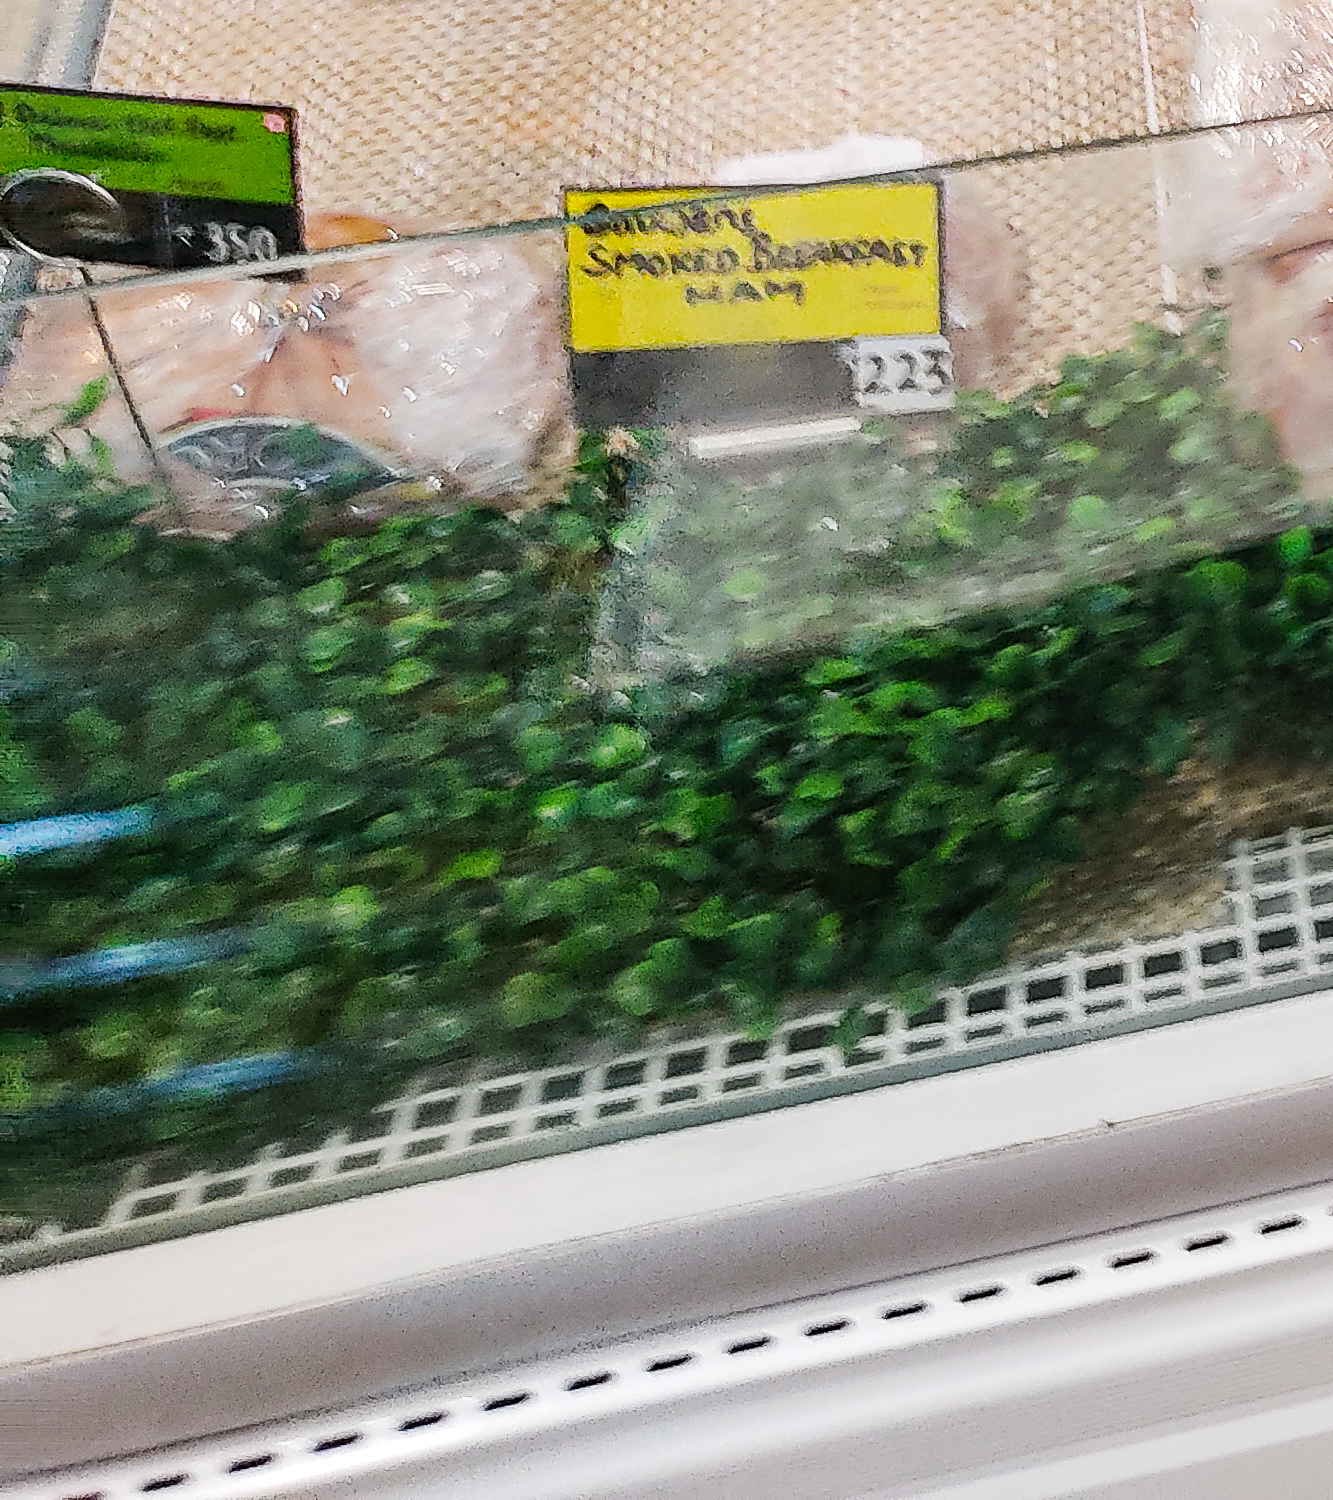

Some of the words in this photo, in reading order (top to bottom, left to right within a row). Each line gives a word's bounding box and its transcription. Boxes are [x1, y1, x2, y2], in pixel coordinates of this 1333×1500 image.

[581, 242, 740, 278] SMOKED
[685, 279, 806, 306] HAM
[862, 345, 952, 397] 223
